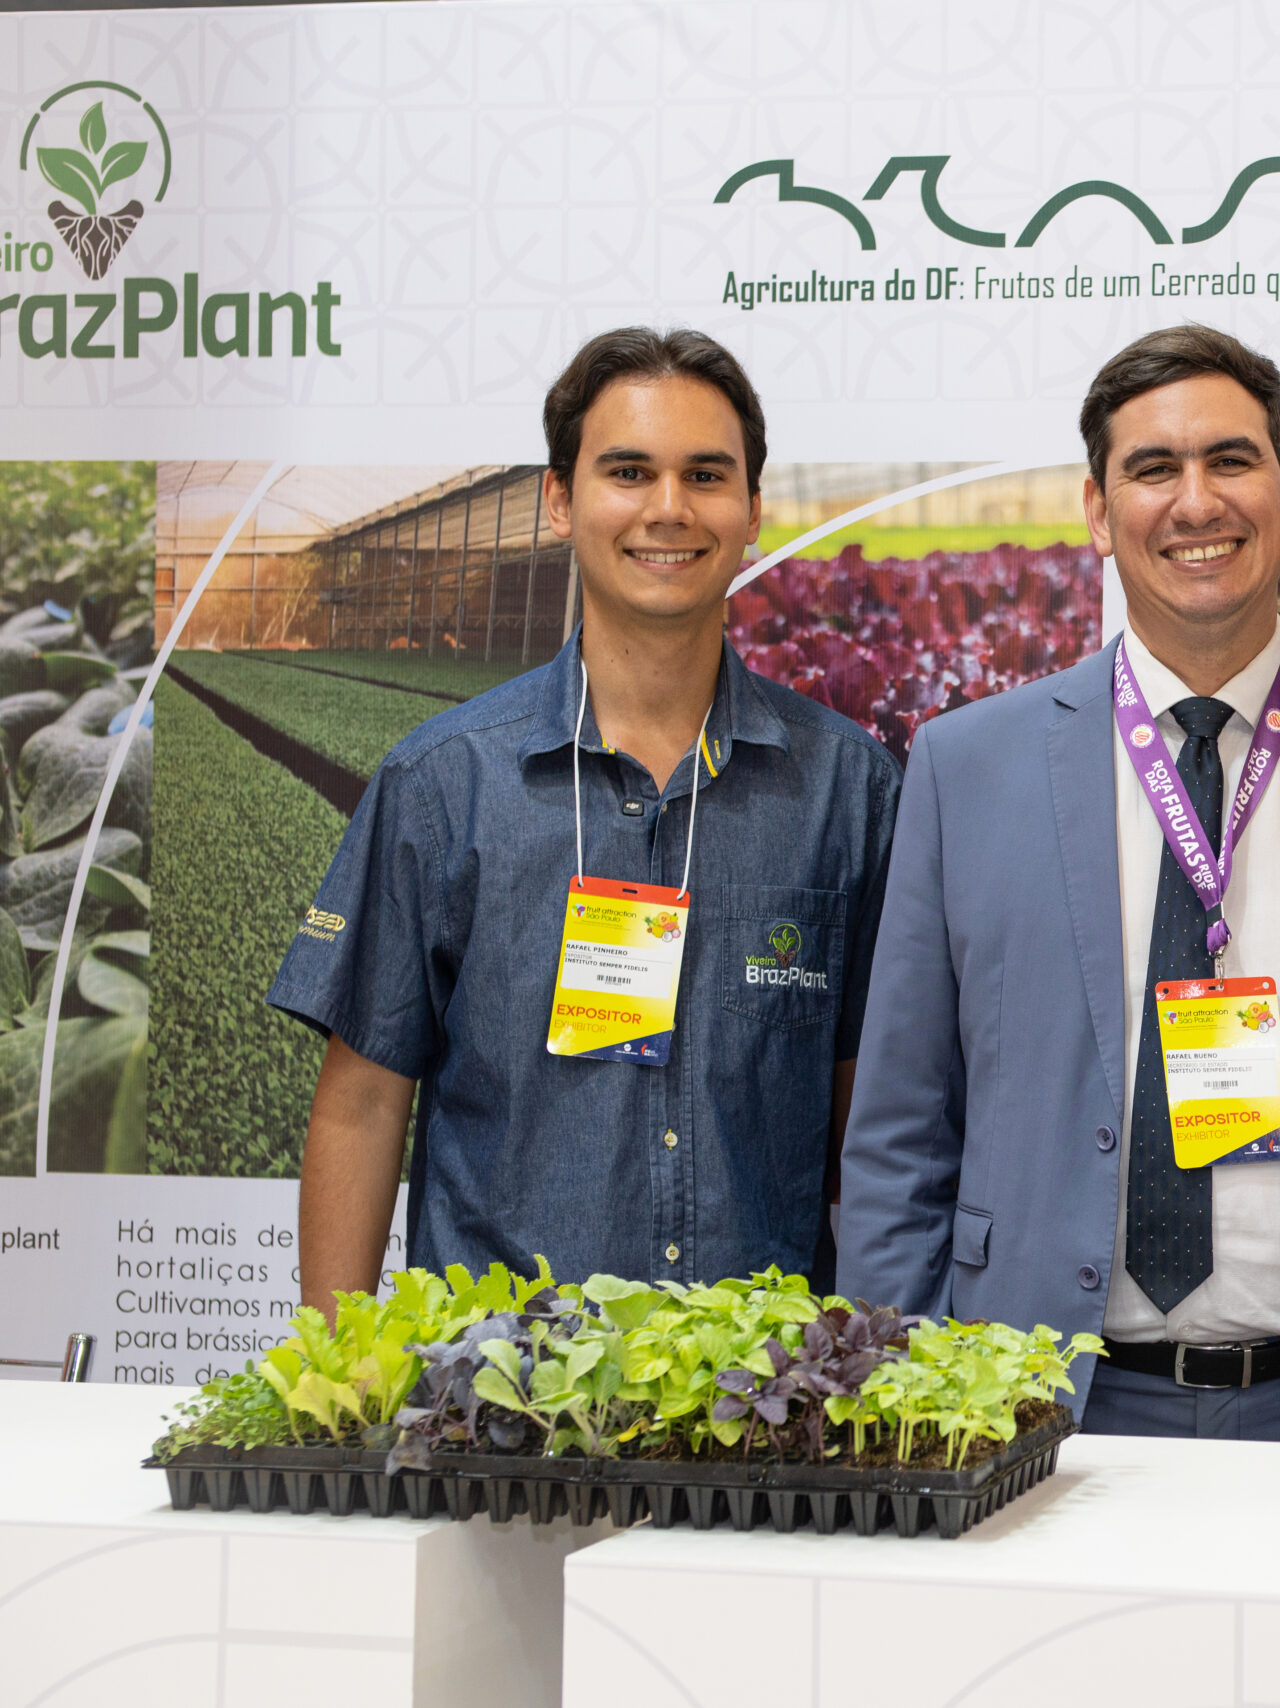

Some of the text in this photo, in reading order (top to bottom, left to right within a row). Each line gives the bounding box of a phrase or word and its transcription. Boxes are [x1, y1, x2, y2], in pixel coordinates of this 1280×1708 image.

[0, 231, 54, 273] iro
[722, 269, 875, 311] Agricultura
[885, 267, 915, 301] do
[925, 266, 965, 301] DF:
[974, 266, 1054, 299] Frutos
[1065, 265, 1093, 298] de
[1104, 274, 1140, 297] um
[1151, 262, 1256, 296] Cerrado
[1117, 692, 1128, 708] DF
[1122, 681, 1138, 707] RIDE
[1248, 747, 1272, 782] ROTA
[1144, 770, 1162, 793] DAS
[1151, 759, 1175, 795] ROTA
[1160, 793, 1206, 868] FRUTAS
[1191, 871, 1207, 890] DF
[1198, 863, 1217, 891] RIDE
[566, 943, 628, 956] RAFAEL PINHEIRO
[745, 954, 777, 966] Viveiro
[564, 957, 598, 966] INSTITUTO
[623, 964, 649, 972] FIDELIS
[746, 965, 828, 989] BrazPlant
[556, 1003, 642, 1025] EXPOSITOR
[554, 1019, 607, 1034] EXHIBITOR
[1175, 1111, 1262, 1128] EXPOSITOR
[1176, 1129, 1230, 1142] EXHIBITOR
[117, 1218, 294, 1248] Há mais de
[117, 1254, 269, 1286] hortaliças
[115, 1289, 261, 1318] Cultivamos
[115, 1330, 177, 1353] para
[114, 1360, 175, 1385] mais
